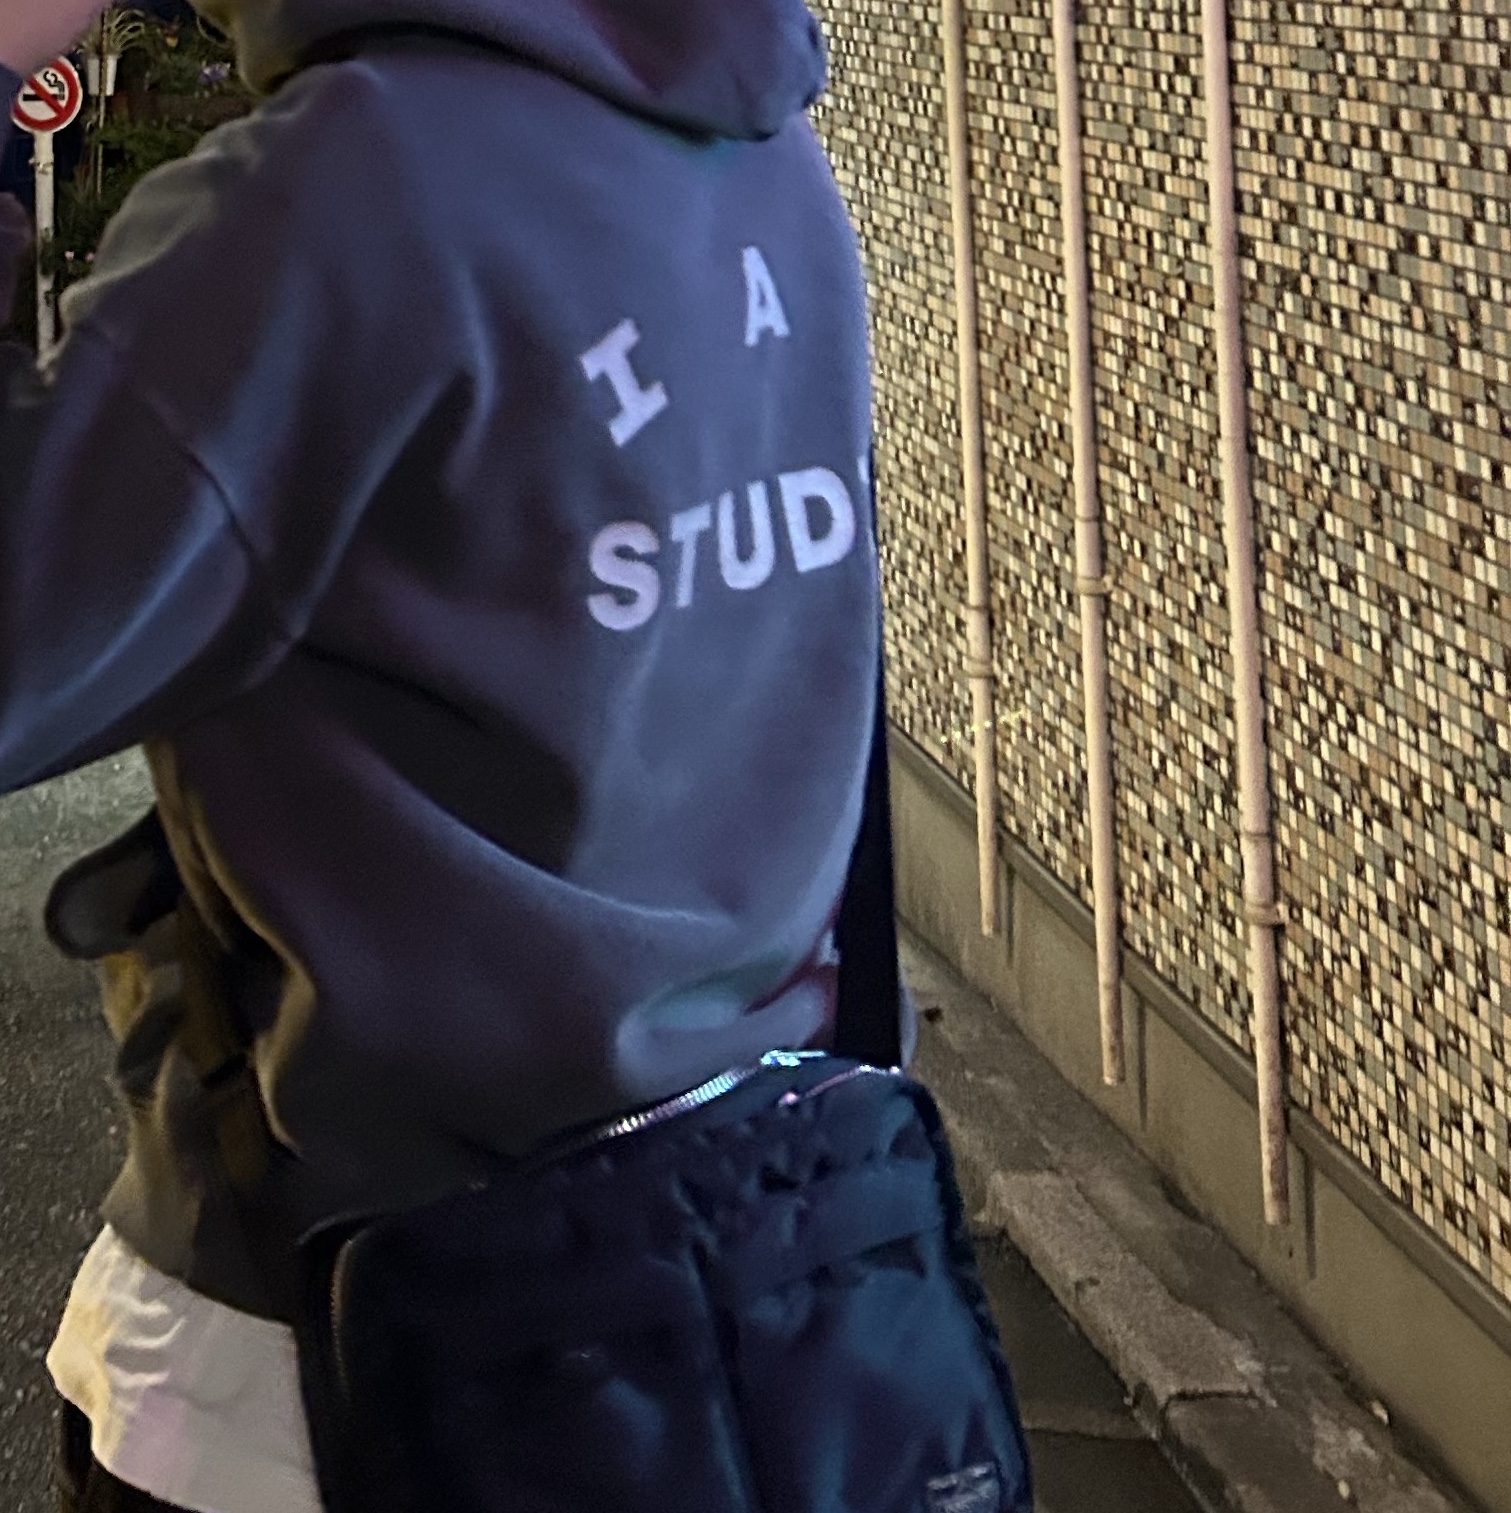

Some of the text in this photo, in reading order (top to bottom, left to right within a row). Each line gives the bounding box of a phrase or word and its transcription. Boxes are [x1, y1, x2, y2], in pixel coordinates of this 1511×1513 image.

[580, 246, 790, 447] I A
[586, 456, 868, 630] STUD
